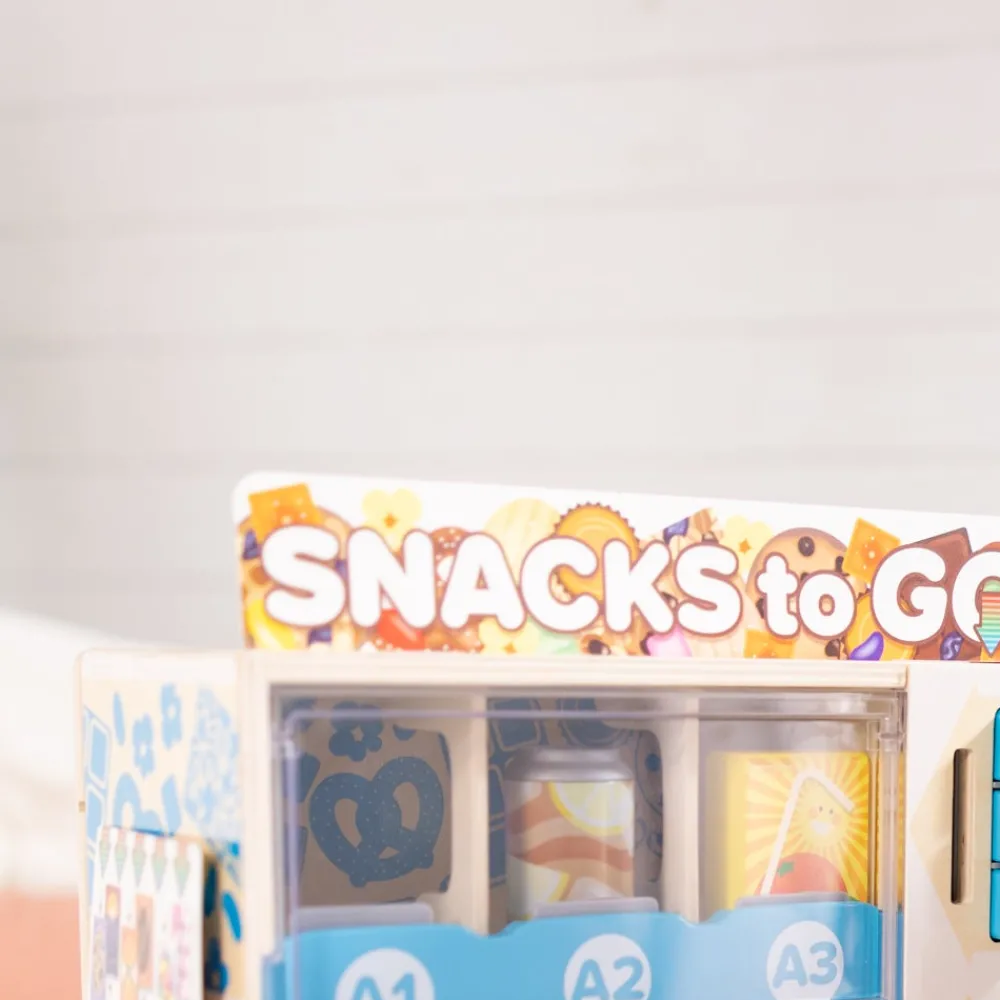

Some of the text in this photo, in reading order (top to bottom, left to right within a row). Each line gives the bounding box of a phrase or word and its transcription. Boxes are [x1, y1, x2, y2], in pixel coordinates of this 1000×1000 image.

[261, 525, 743, 635] SNACKS
[755, 551, 856, 639] to
[772, 941, 838, 989] A3
